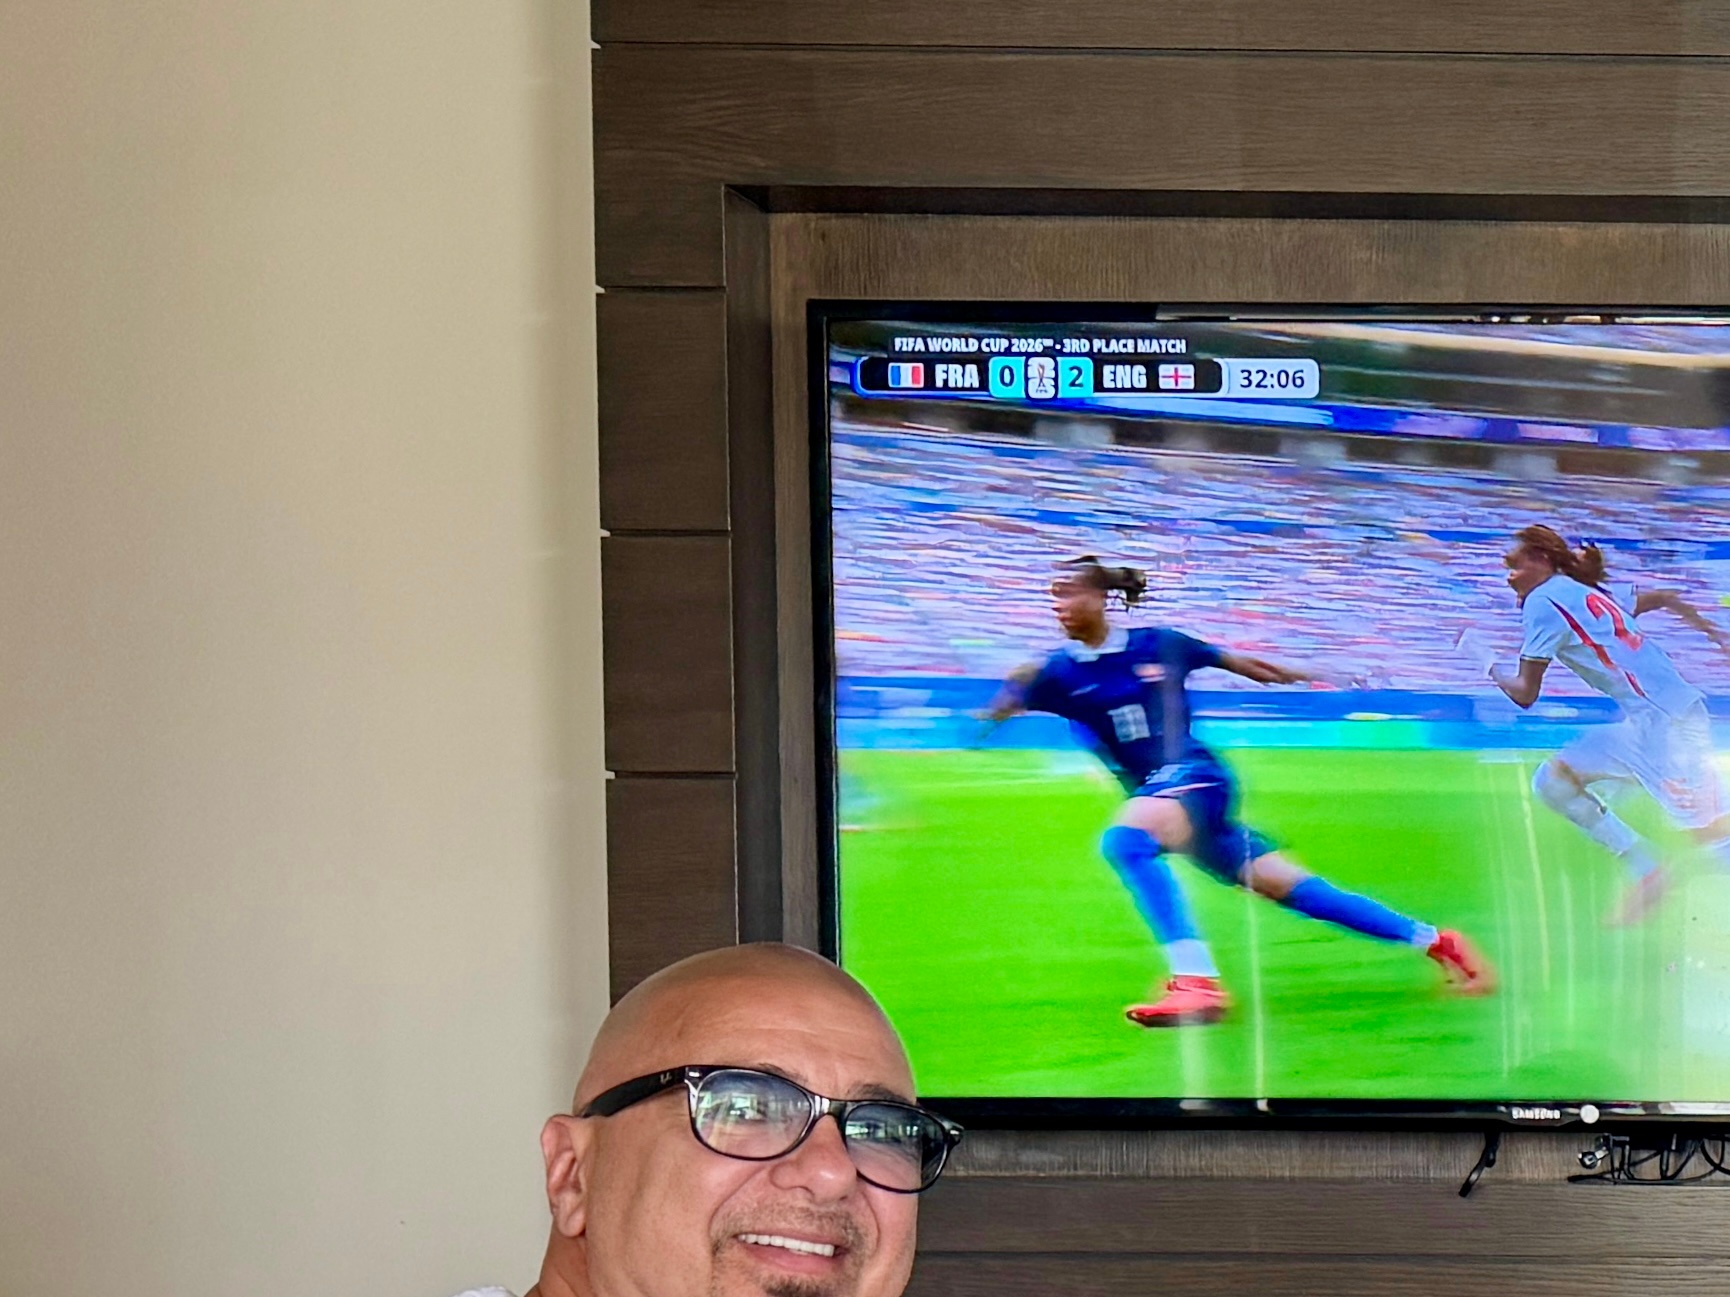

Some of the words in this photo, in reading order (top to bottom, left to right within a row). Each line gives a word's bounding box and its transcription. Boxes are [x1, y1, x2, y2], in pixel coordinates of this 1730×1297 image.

[894, 337, 926, 352] FIFA
[927, 337, 979, 352] WORLD
[981, 338, 1009, 353] CUP
[1062, 338, 1090, 353] 3RD
[1092, 338, 1135, 353] PLACE
[1137, 338, 1187, 354] MATCH
[935, 364, 979, 388] FRA
[999, 365, 1015, 387] 0
[1068, 365, 1084, 388] 2
[1103, 364, 1147, 388] ENG
[1240, 369, 1305, 389] 32:06
